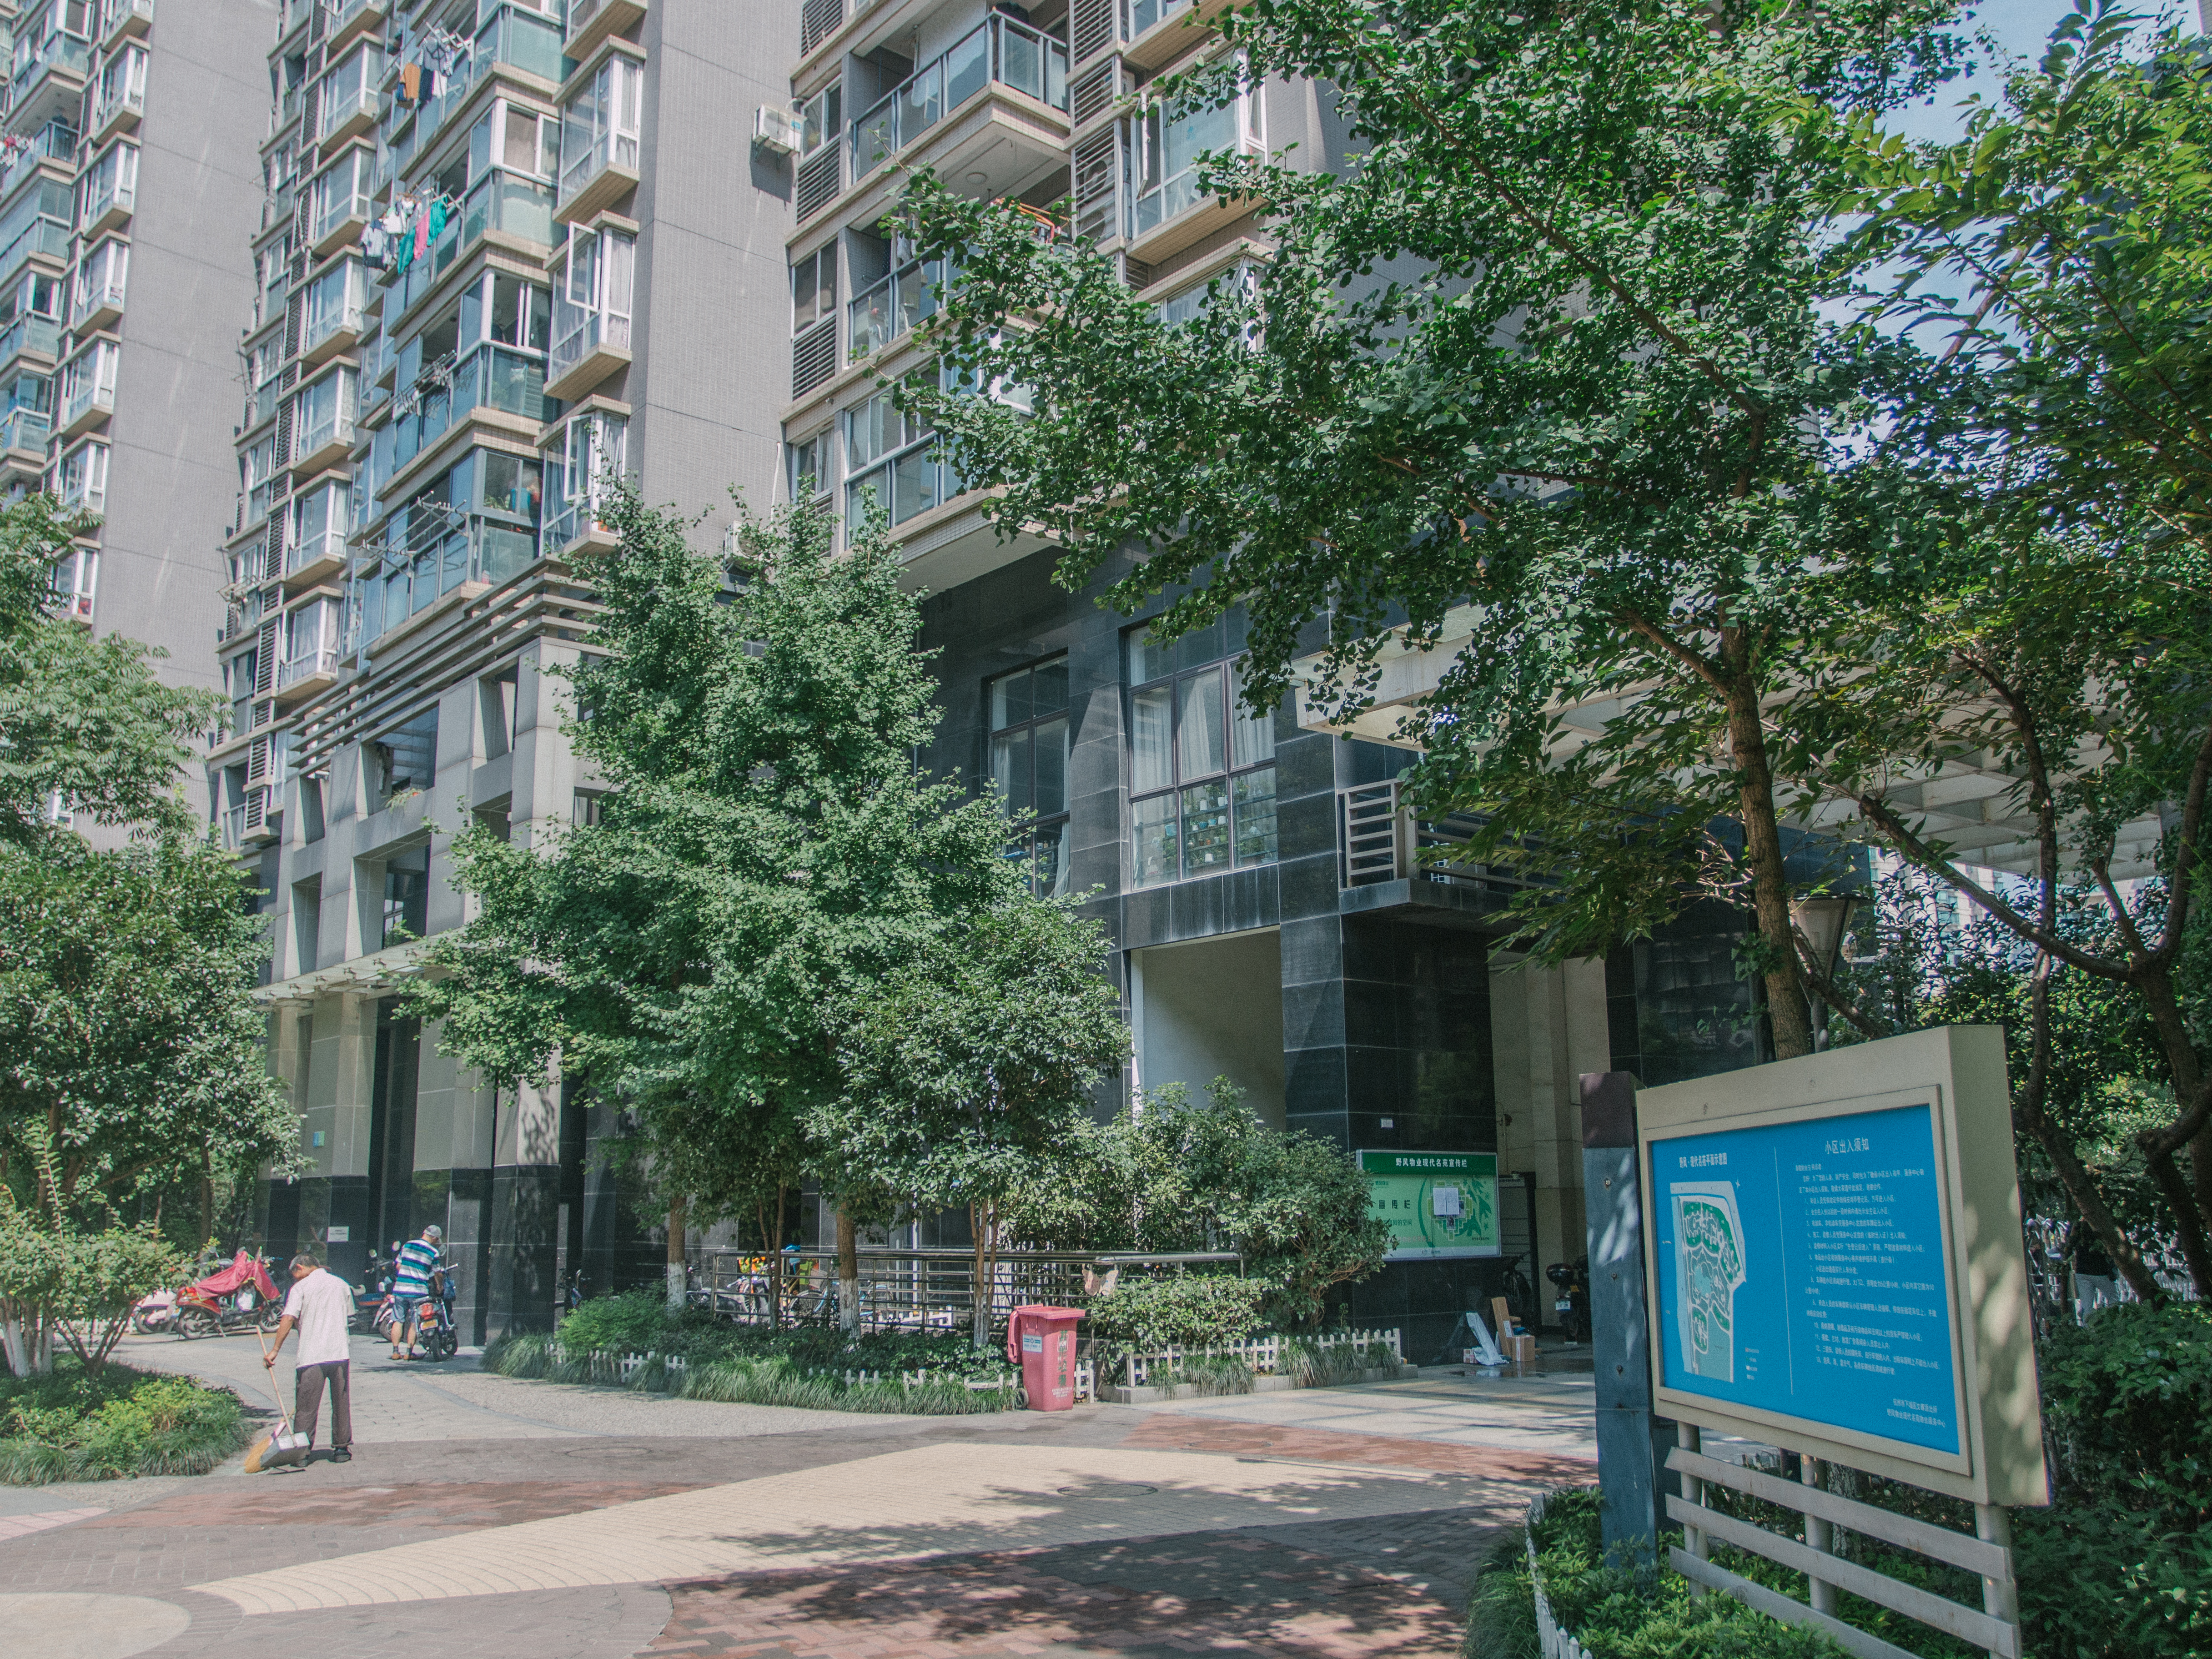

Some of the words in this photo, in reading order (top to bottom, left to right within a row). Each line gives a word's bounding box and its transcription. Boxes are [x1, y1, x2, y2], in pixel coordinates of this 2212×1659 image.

[1825, 1137, 1869, 1155] 小区出入须知
[1396, 1158, 1468, 1168] 野风物业现代名苑宣传栏
[1379, 1199, 1411, 1209] 宣传栏
